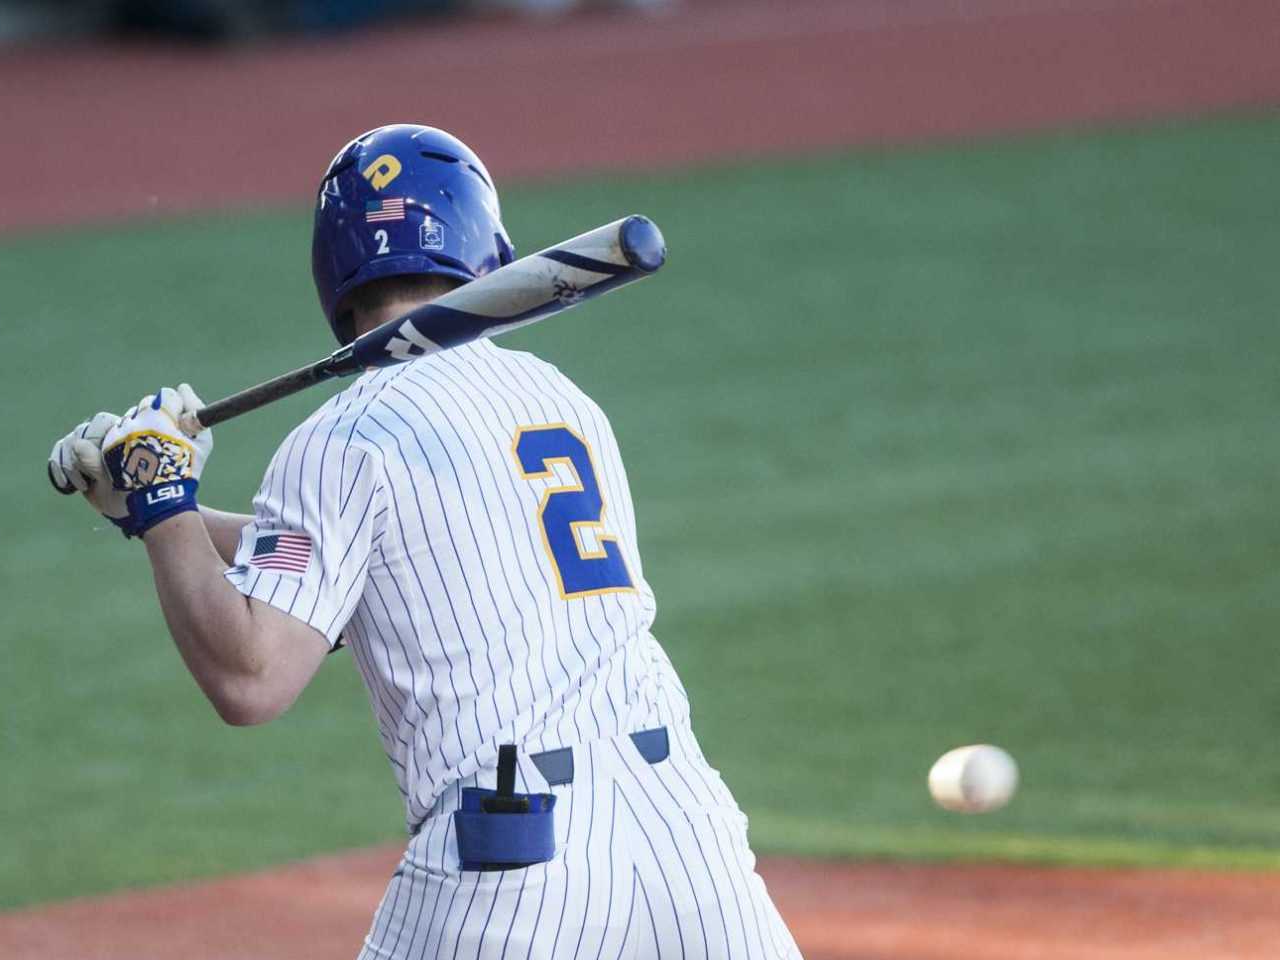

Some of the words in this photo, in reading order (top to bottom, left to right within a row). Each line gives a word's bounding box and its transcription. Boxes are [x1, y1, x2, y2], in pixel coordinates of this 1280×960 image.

[374, 229, 390, 254] 2
[146, 484, 184, 505] LSU
[511, 421, 640, 600] 2
